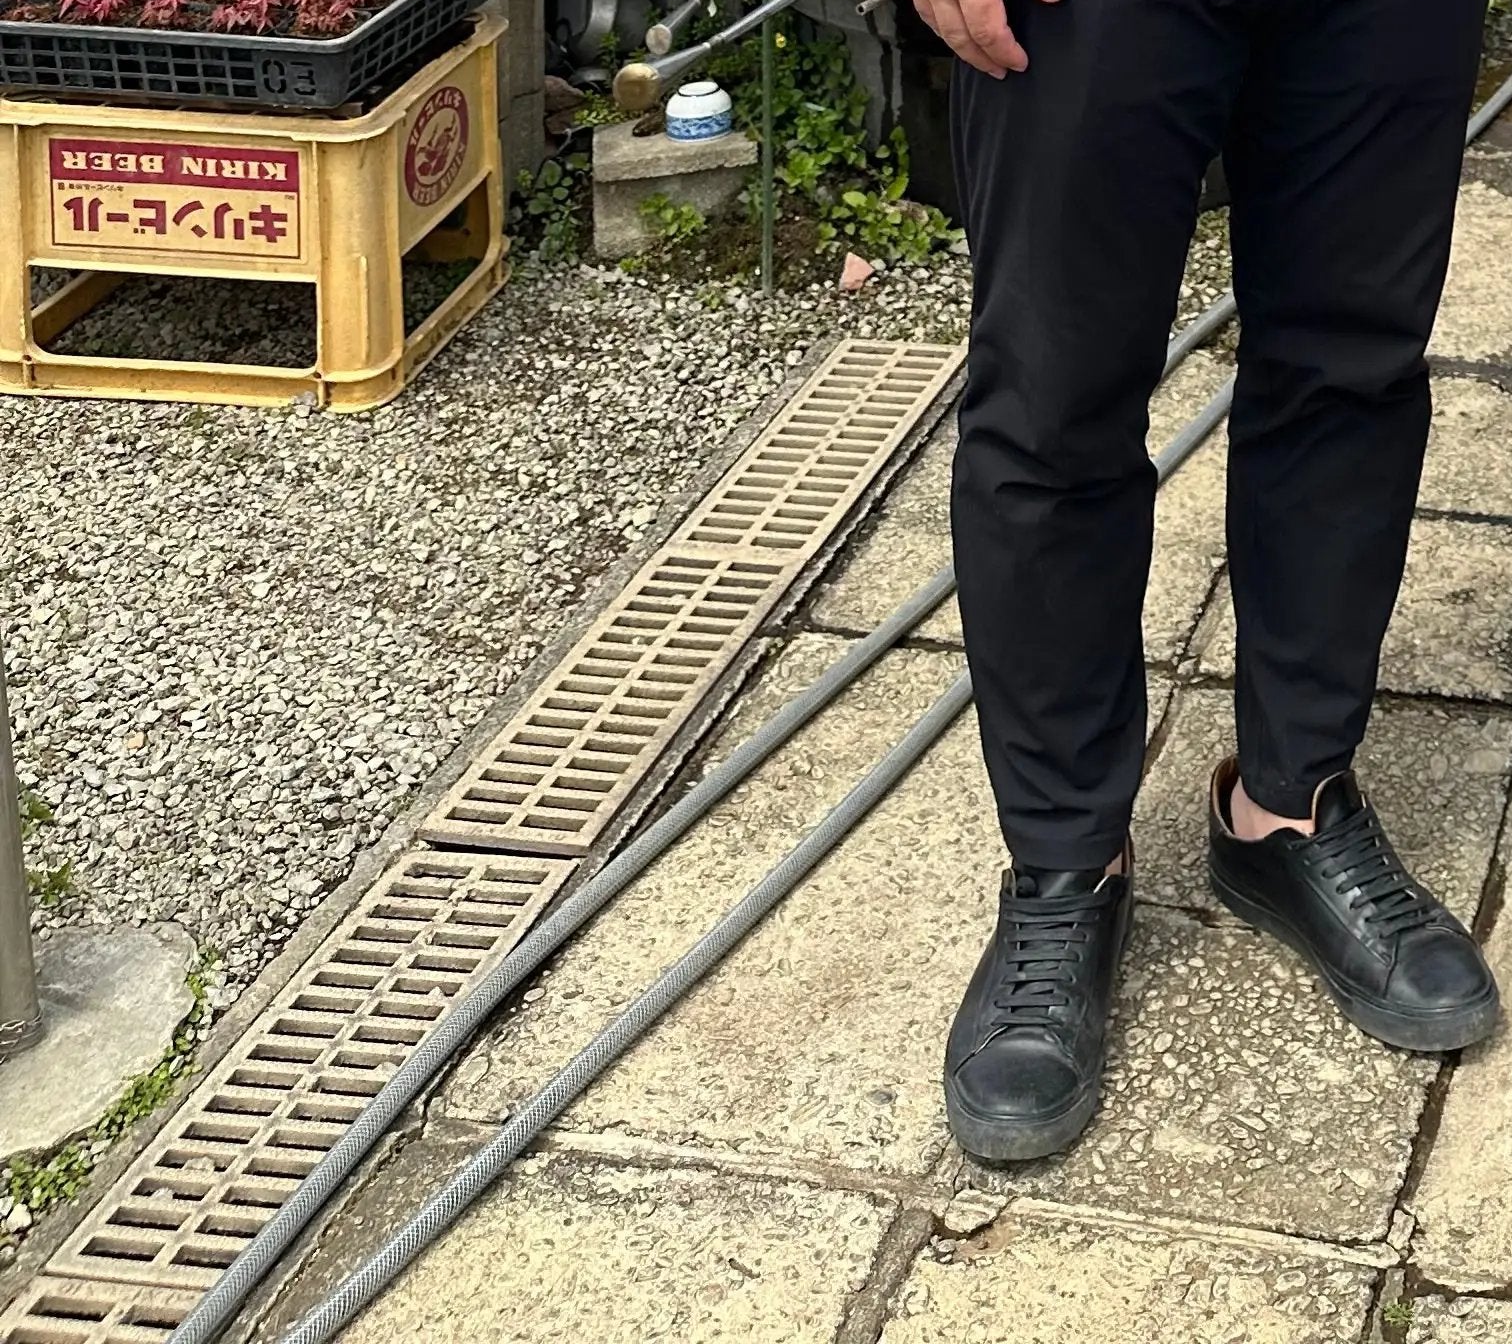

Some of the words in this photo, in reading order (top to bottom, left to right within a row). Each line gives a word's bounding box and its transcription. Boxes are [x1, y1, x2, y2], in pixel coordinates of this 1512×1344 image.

[61, 150, 164, 174] BEER
[181, 156, 288, 181] KIRIN
[63, 196, 288, 244] キリンビール
